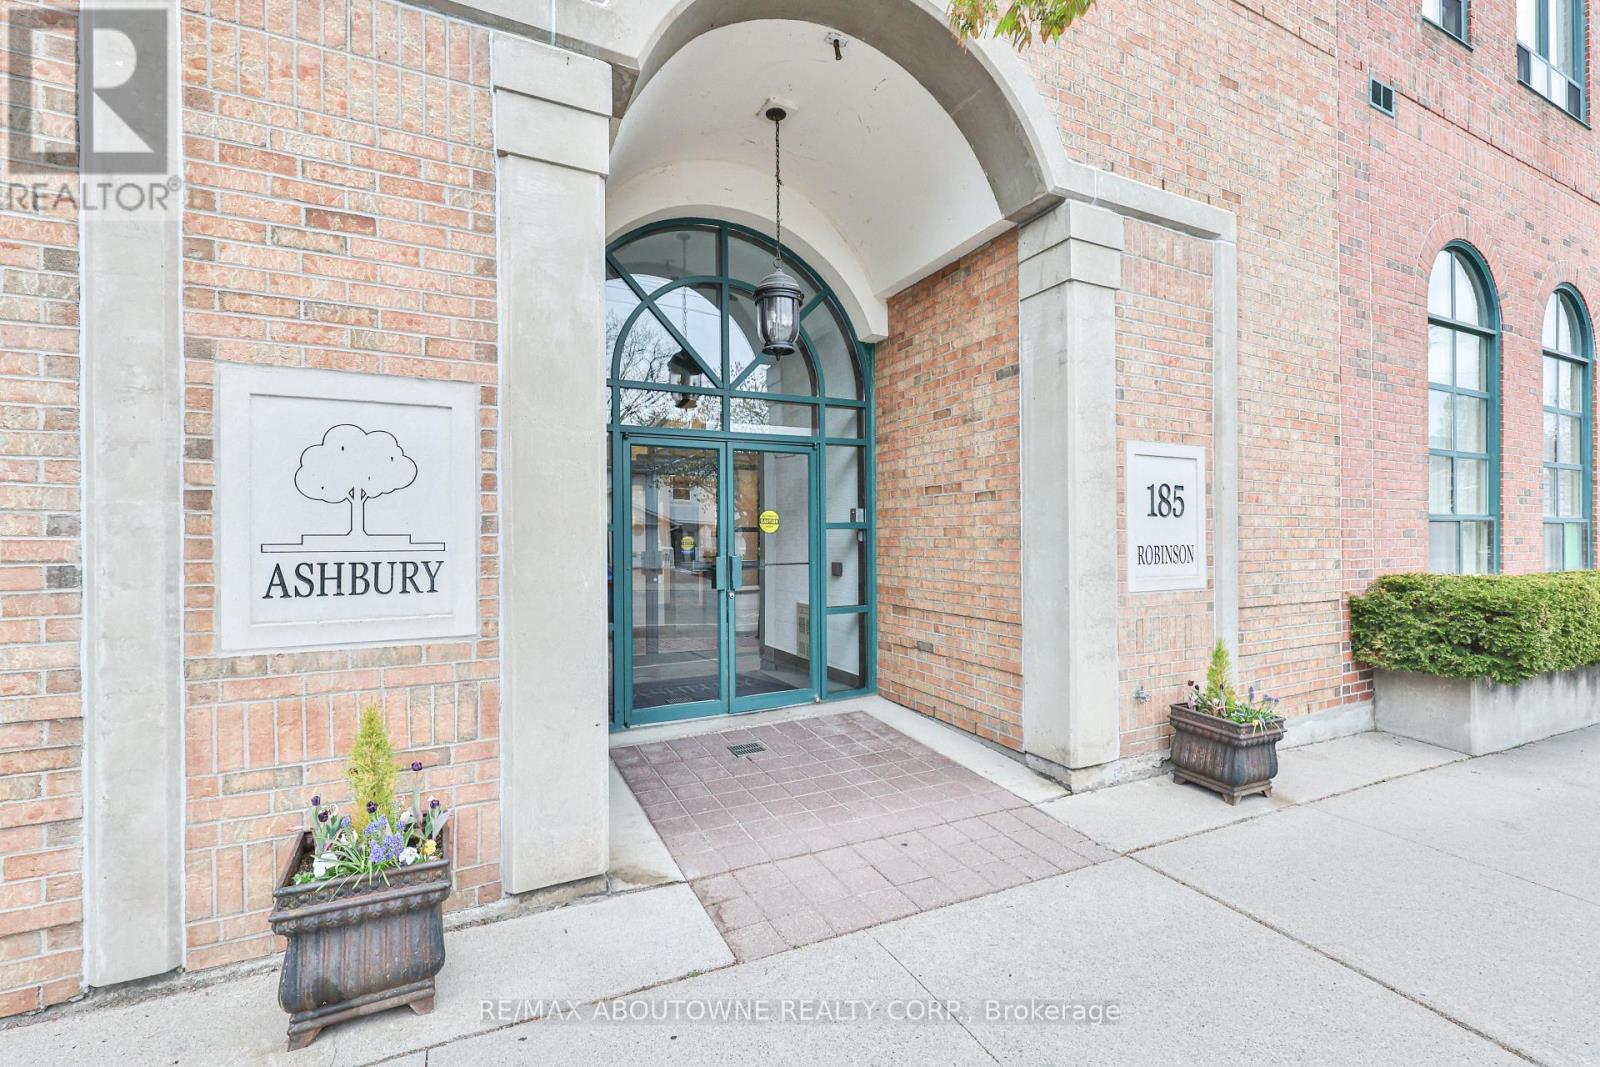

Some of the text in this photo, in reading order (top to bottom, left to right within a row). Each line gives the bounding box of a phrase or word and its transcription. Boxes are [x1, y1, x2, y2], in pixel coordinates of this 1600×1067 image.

[1147, 483, 1185, 518] 185
[1137, 544, 1195, 565] ROBINSON
[262, 560, 444, 599] ASHBURY
